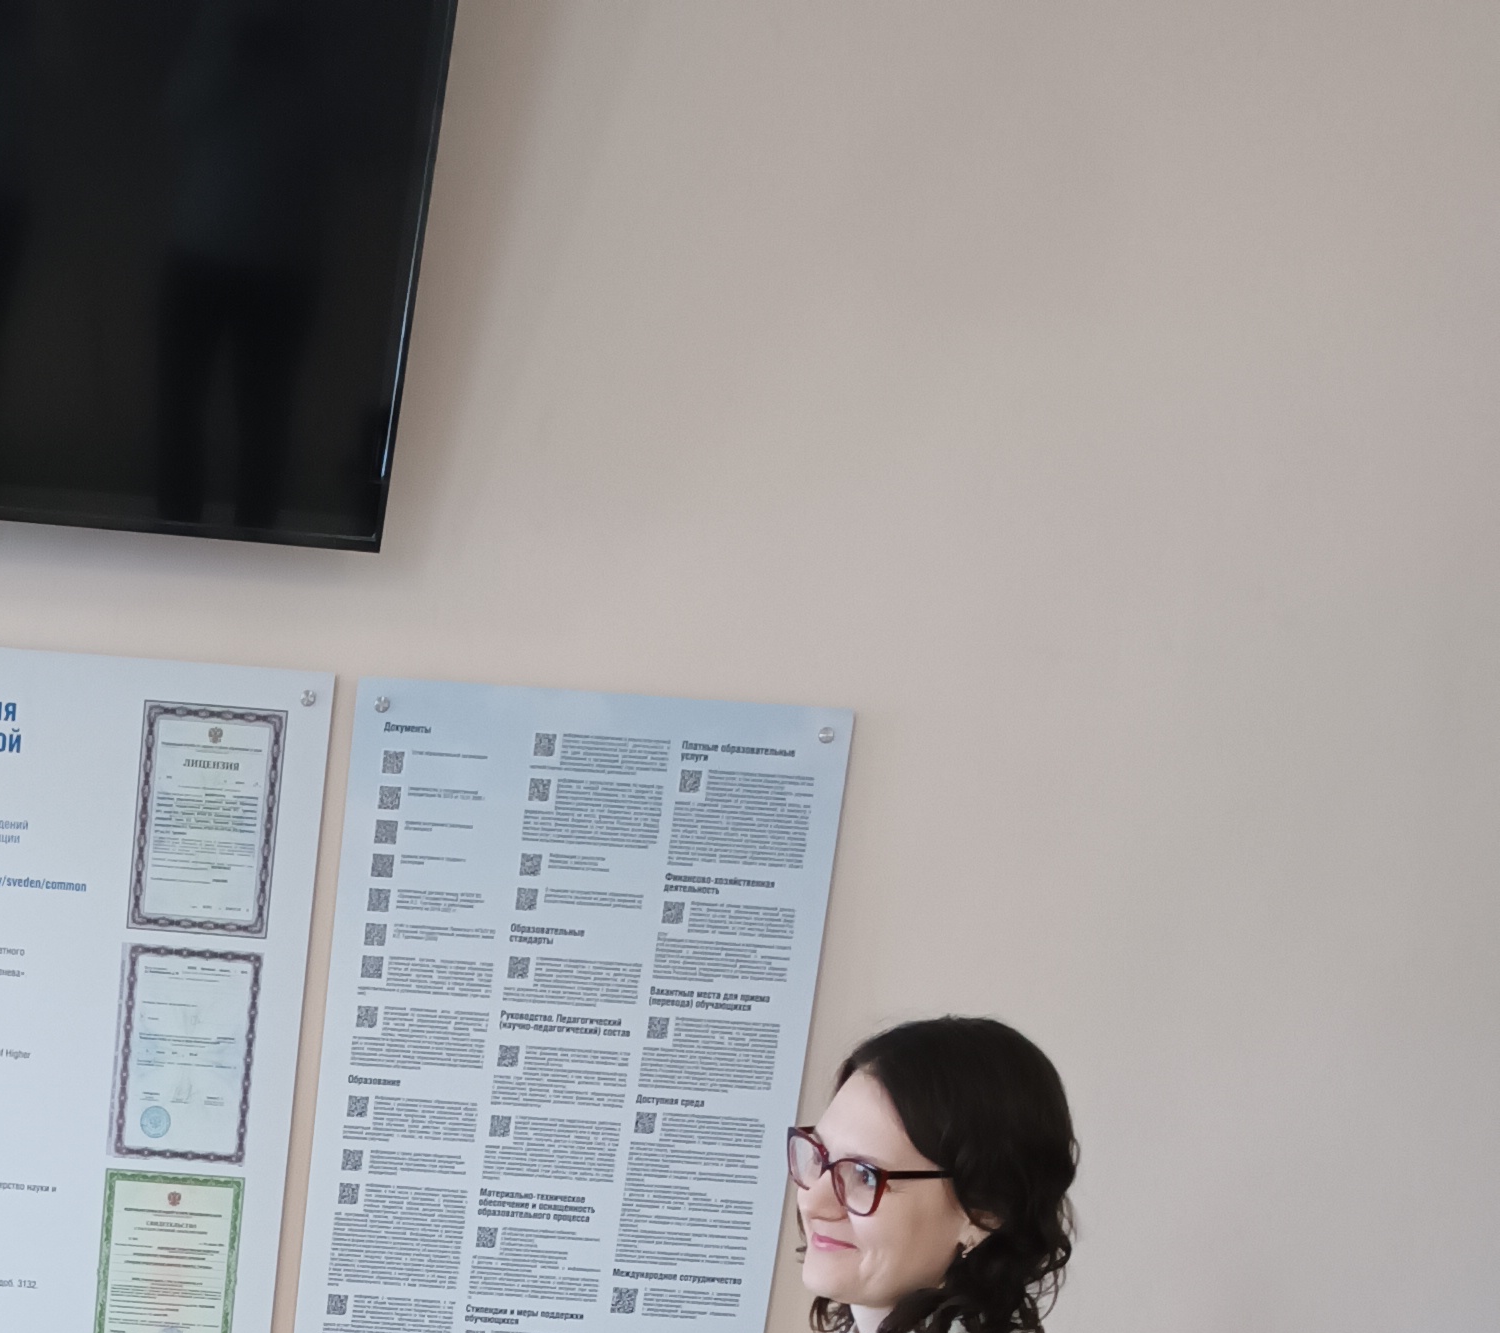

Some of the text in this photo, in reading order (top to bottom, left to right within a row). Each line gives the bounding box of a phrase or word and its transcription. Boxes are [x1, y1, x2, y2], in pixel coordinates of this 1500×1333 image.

[384, 722, 431, 734] Документы
[682, 741, 795, 757] Платные образовательные
[183, 759, 239, 770] ЛИЦЕНЗИЯ
[680, 753, 708, 762] услуги
[665, 873, 775, 888] Финансово-хозяйственная
[663, 885, 719, 894] деятельность
[510, 924, 585, 937] Образовательные
[509, 935, 553, 946] стандарты
[650, 986, 770, 1003] Вакантные места для приема
[648, 996, 751, 1011] (перевода) обучающихся
[500, 1010, 622, 1026] Руководство. Педагогический
[499, 1020, 630, 1037] (научно-педагогический) состав
[348, 1075, 401, 1086] Образование
[635, 1094, 704, 1108] Доступная среда
[479, 1188, 585, 1203] Материально-техническое
[478, 1198, 529, 1209] обеспечение
[538, 1204, 595, 1213] оснащенность
[477, 1207, 590, 1222] образовательного процесса
[612, 1268, 742, 1284] Международное сотрудничество
[464, 1314, 519, 1324] обучающихся
[466, 1304, 507, 1315] Стипендии
[516, 1309, 538, 1318] меры
[540, 1311, 584, 1320] поддержки
